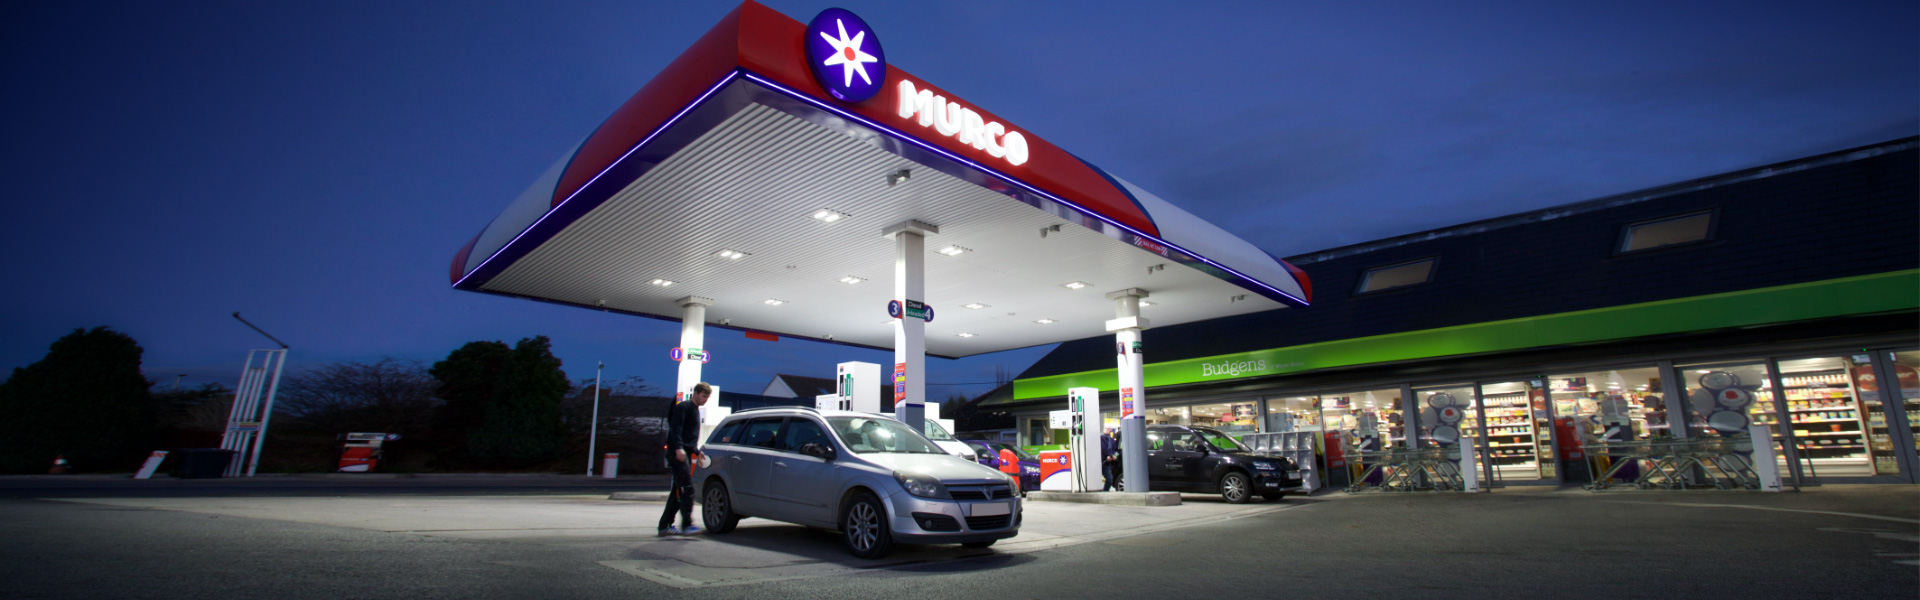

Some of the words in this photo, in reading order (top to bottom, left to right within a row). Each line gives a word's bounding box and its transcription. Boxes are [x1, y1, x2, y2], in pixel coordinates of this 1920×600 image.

[897, 79, 1028, 166] MURCO
[891, 302, 898, 315] 3
[924, 308, 931, 320] 4
[701, 352, 708, 362] 2
[1202, 359, 1266, 376] Budgens
